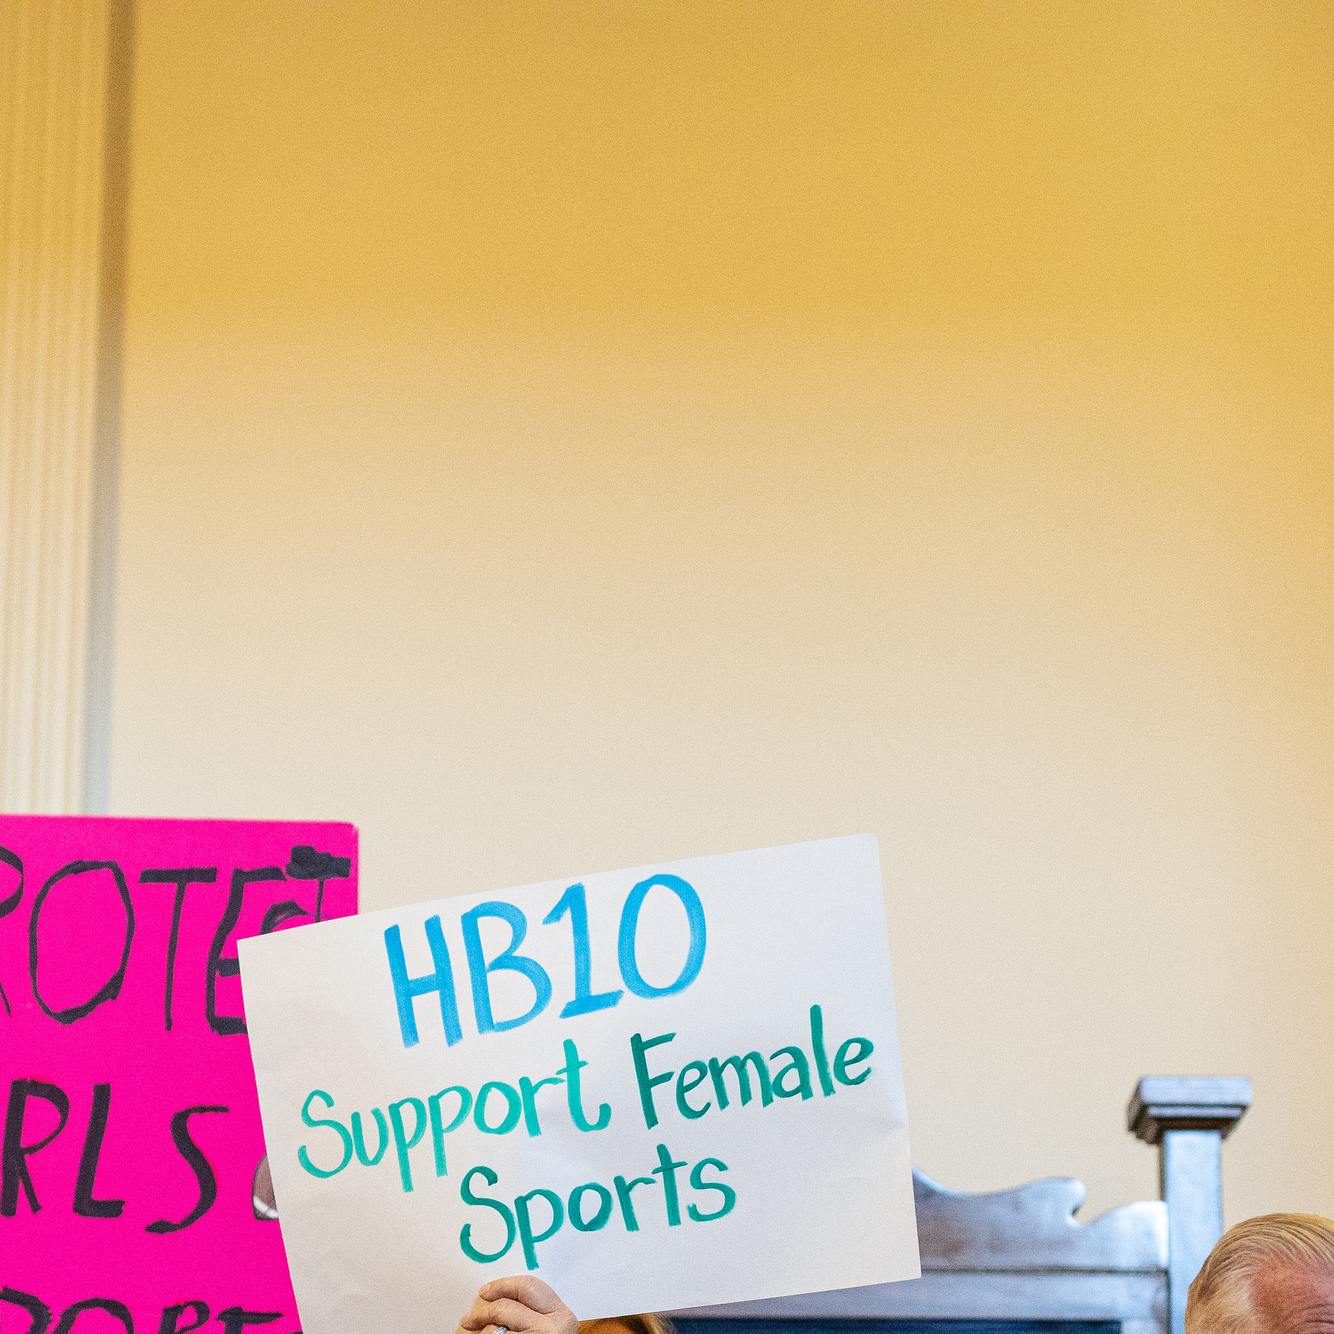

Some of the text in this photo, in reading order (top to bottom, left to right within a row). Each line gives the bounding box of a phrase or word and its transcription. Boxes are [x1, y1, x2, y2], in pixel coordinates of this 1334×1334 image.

[383, 873, 707, 1049] HB10
[297, 1004, 875, 1193] Support Female
[459, 1143, 738, 1271] Sports
